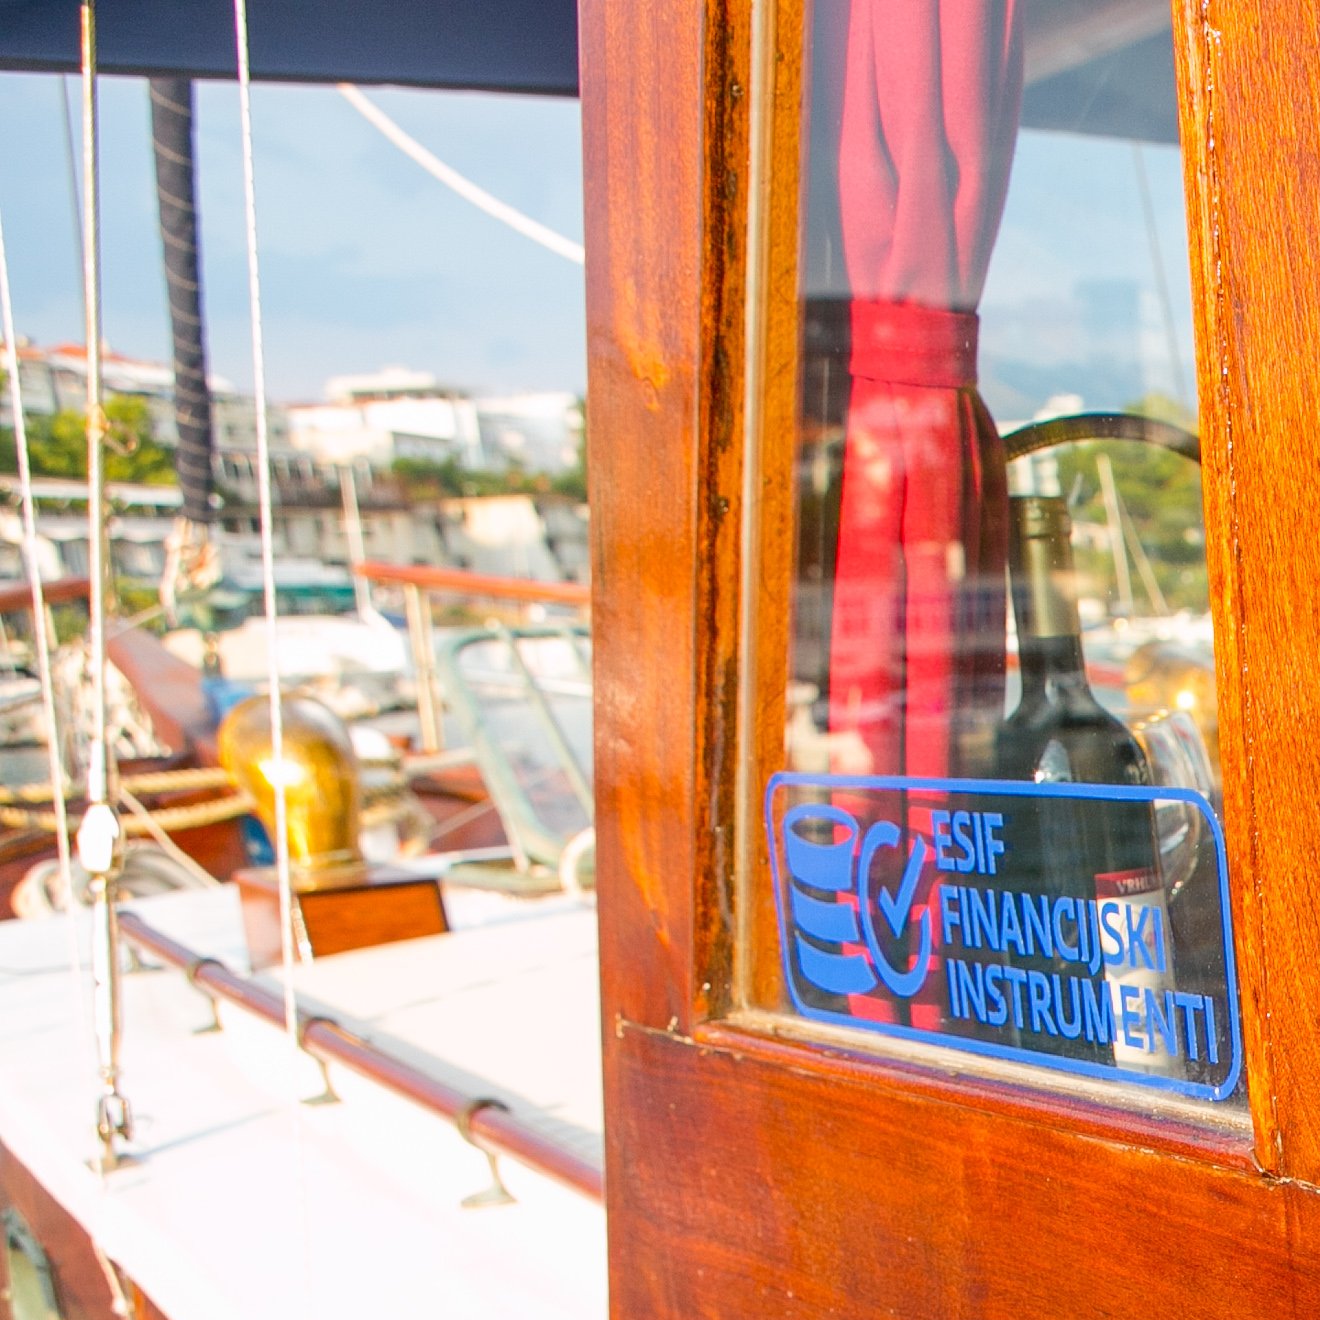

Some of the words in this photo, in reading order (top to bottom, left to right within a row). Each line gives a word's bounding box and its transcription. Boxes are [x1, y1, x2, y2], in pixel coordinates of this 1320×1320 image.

[931, 809, 1004, 875] ESIF
[938, 883, 1166, 976] FINANCIJSKI
[946, 958, 1219, 1065] INSTRUMENTI
